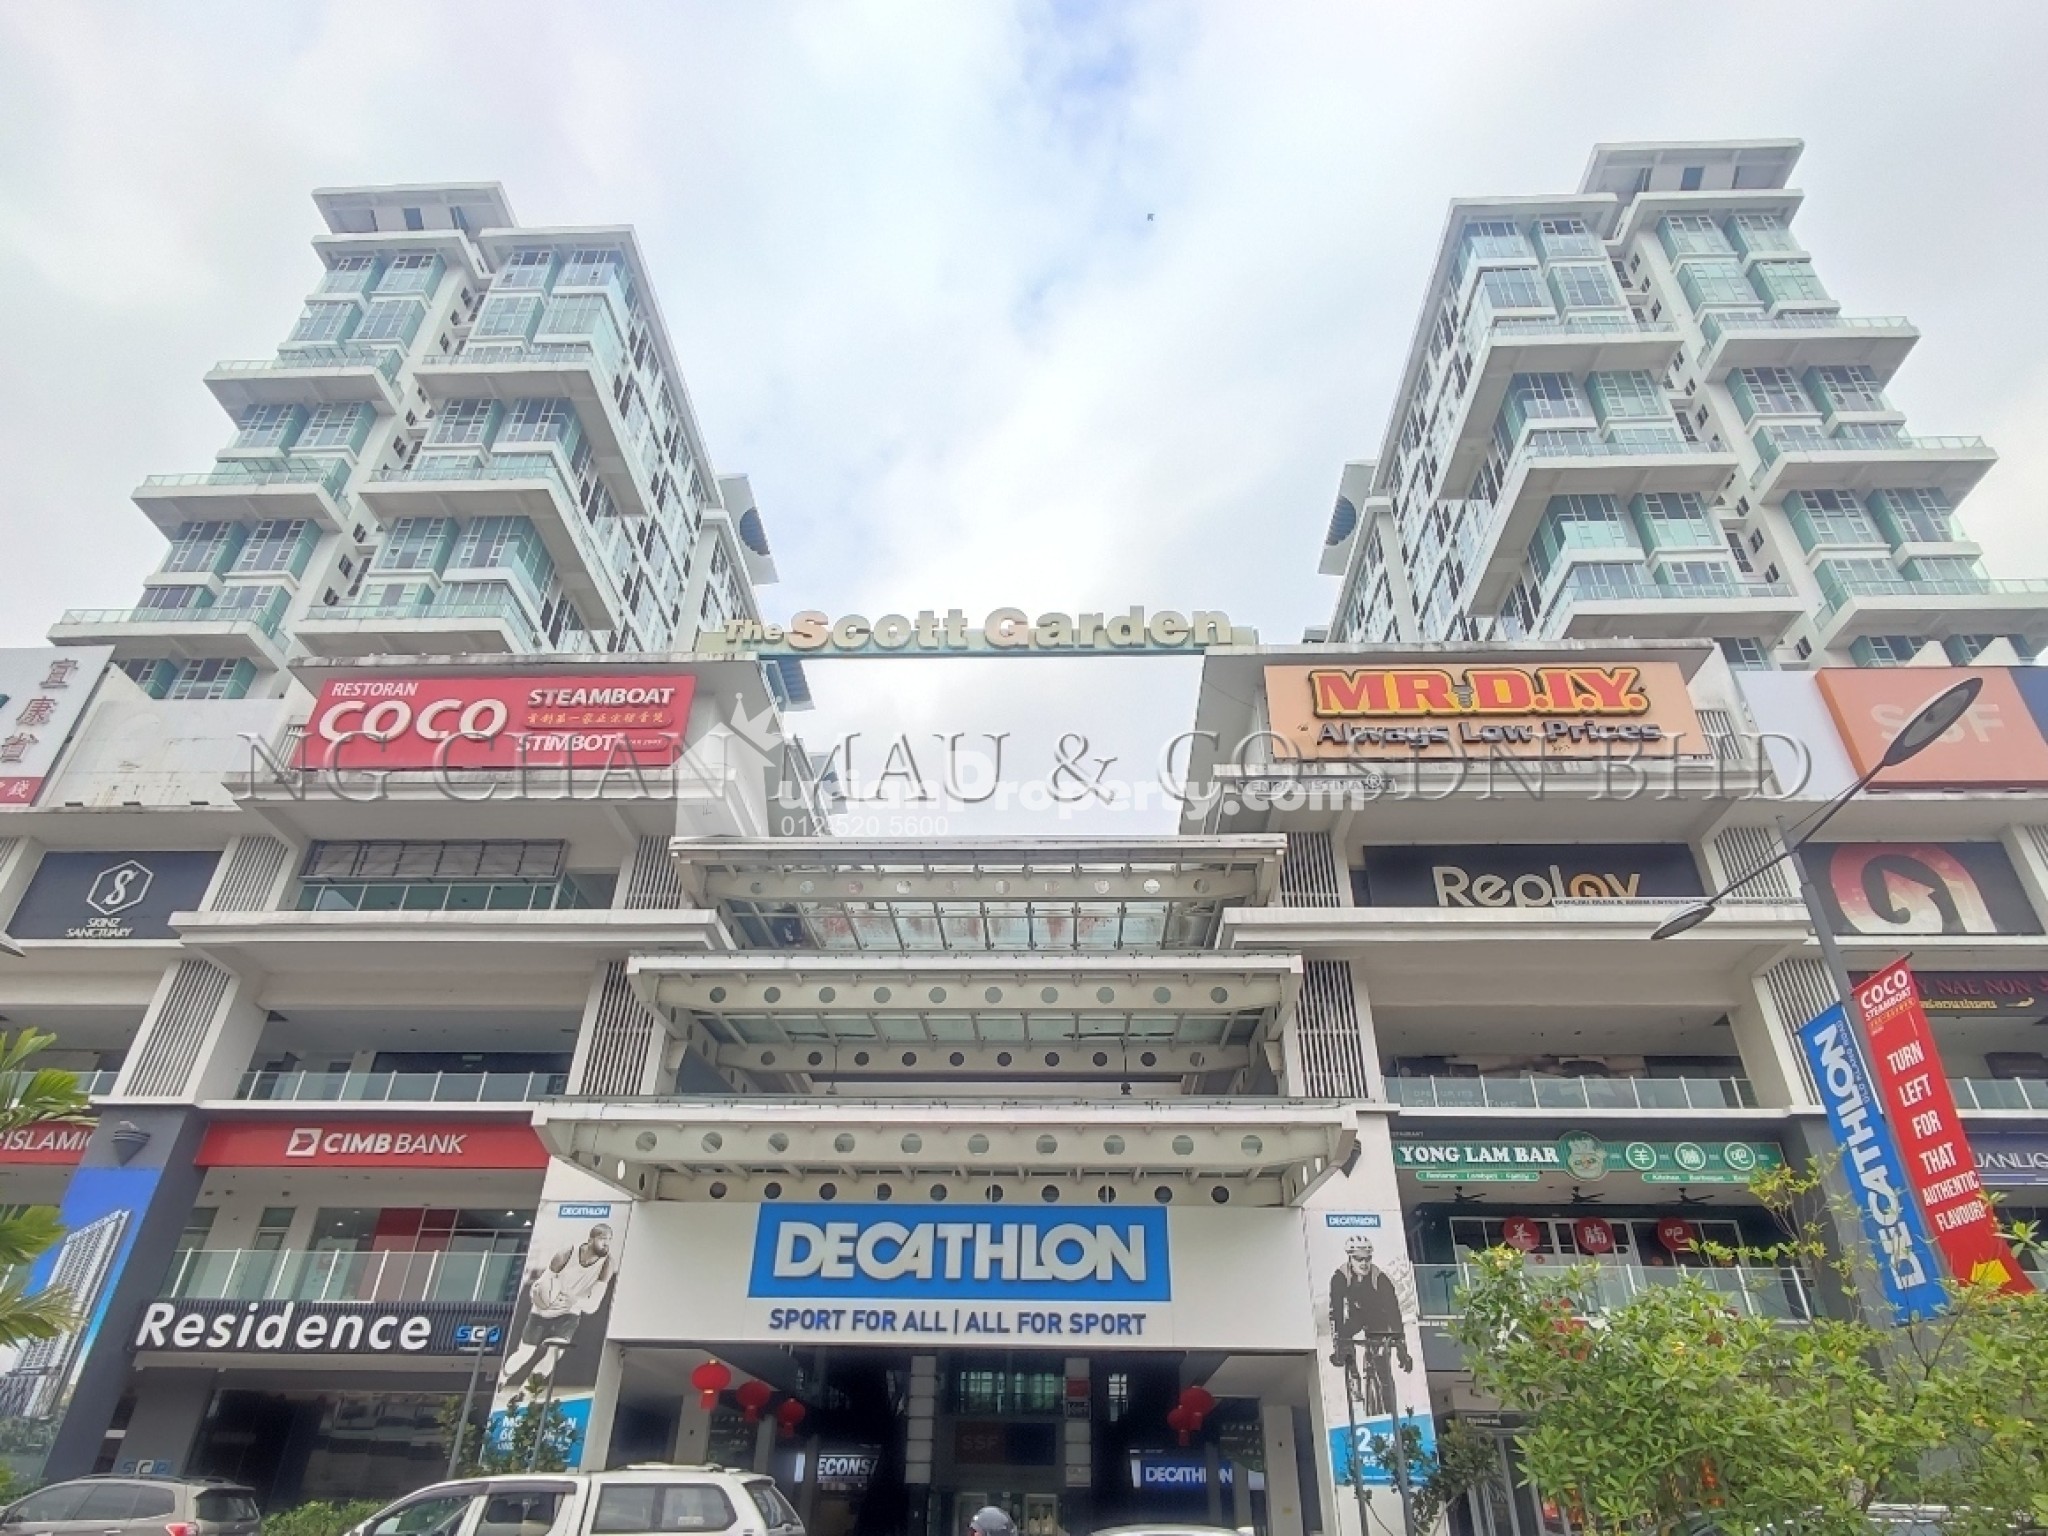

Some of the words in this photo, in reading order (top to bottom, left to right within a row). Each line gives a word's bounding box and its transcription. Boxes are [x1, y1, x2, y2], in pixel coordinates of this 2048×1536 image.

[723, 618, 783, 643] The
[787, 610, 968, 651] Scott
[984, 605, 1232, 651] Garden
[331, 682, 418, 697] RESTORAN
[528, 687, 675, 706] STEAMBOAT
[318, 698, 508, 743] COCO
[1317, 722, 1449, 748] Always
[1459, 721, 1533, 743] Low
[1542, 719, 1661, 742] Prices
[1861, 968, 1908, 1009] COCO
[1887, 1040, 1924, 1075] TURN
[1898, 1073, 1932, 1107] LEFT
[1912, 1110, 1942, 1139] FOR
[324, 1132, 393, 1153] CIMB
[394, 1133, 468, 1154] BANK
[1398, 1146, 1460, 1163] YONG
[1464, 1146, 1510, 1163] LAM
[1513, 1146, 1560, 1163] BAR
[1814, 1024, 1927, 1290] DECATHLON
[1919, 1142, 1957, 1175] THAT
[1922, 1170, 1980, 1207] AUTHENTIC
[561, 1206, 608, 1216] DECATHLON
[773, 1220, 1147, 1282] DECATHLON
[135, 1301, 432, 1351] Residence
[769, 1307, 846, 1331] SPORT
[852, 1308, 897, 1331] FOR
[902, 1309, 947, 1332] ALL
[965, 1310, 1010, 1333] ALL
[1017, 1310, 1063, 1334] FOR
[1069, 1311, 1147, 1335] SPORT
